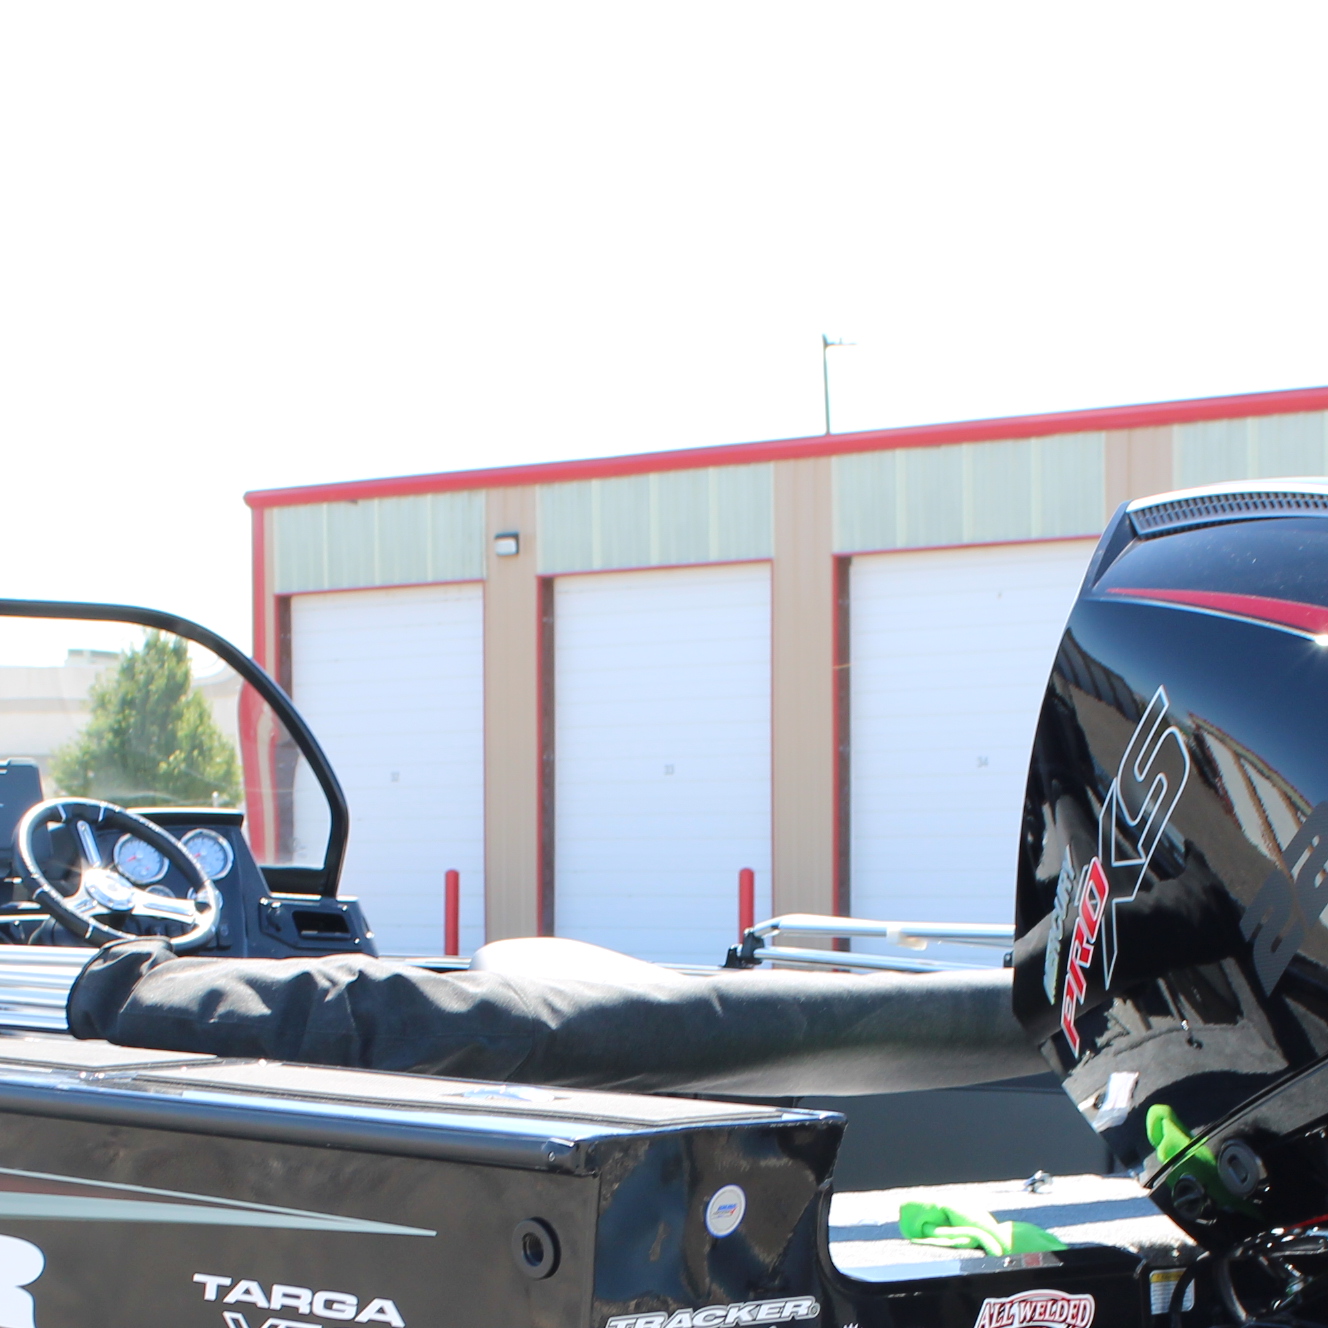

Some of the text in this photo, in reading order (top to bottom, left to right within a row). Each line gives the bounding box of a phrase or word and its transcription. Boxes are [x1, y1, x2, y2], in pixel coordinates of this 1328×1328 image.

[1060, 856, 1109, 1059] PRO
[193, 1273, 406, 1328] TARGA
[1019, 1298, 1092, 1328] WELDED
